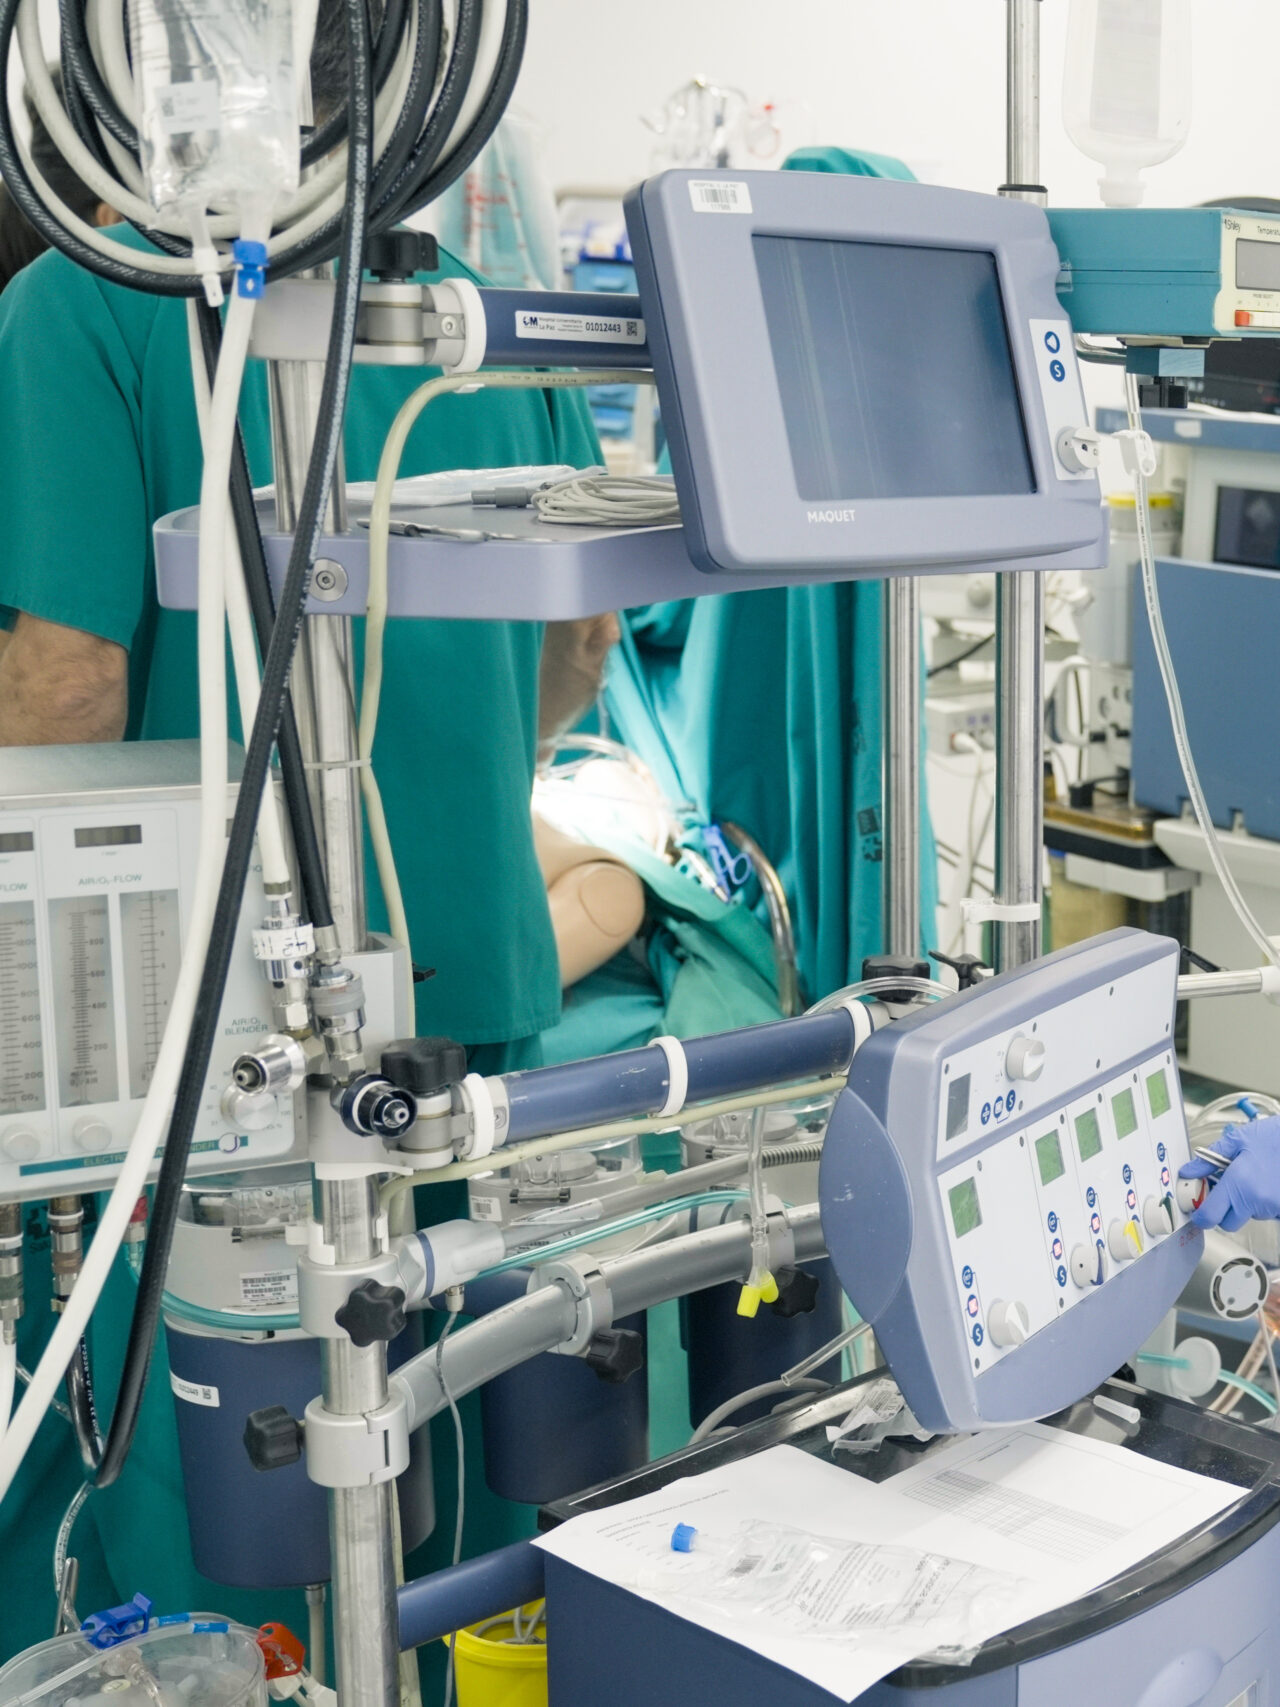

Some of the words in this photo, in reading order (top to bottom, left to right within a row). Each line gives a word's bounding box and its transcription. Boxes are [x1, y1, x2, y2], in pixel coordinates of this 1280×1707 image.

[585, 321, 622, 333] 01012443
[807, 509, 856, 524] MAQUET
[224, 1024, 268, 1036] BLENDER
[24, 1071, 43, 1080] 200
